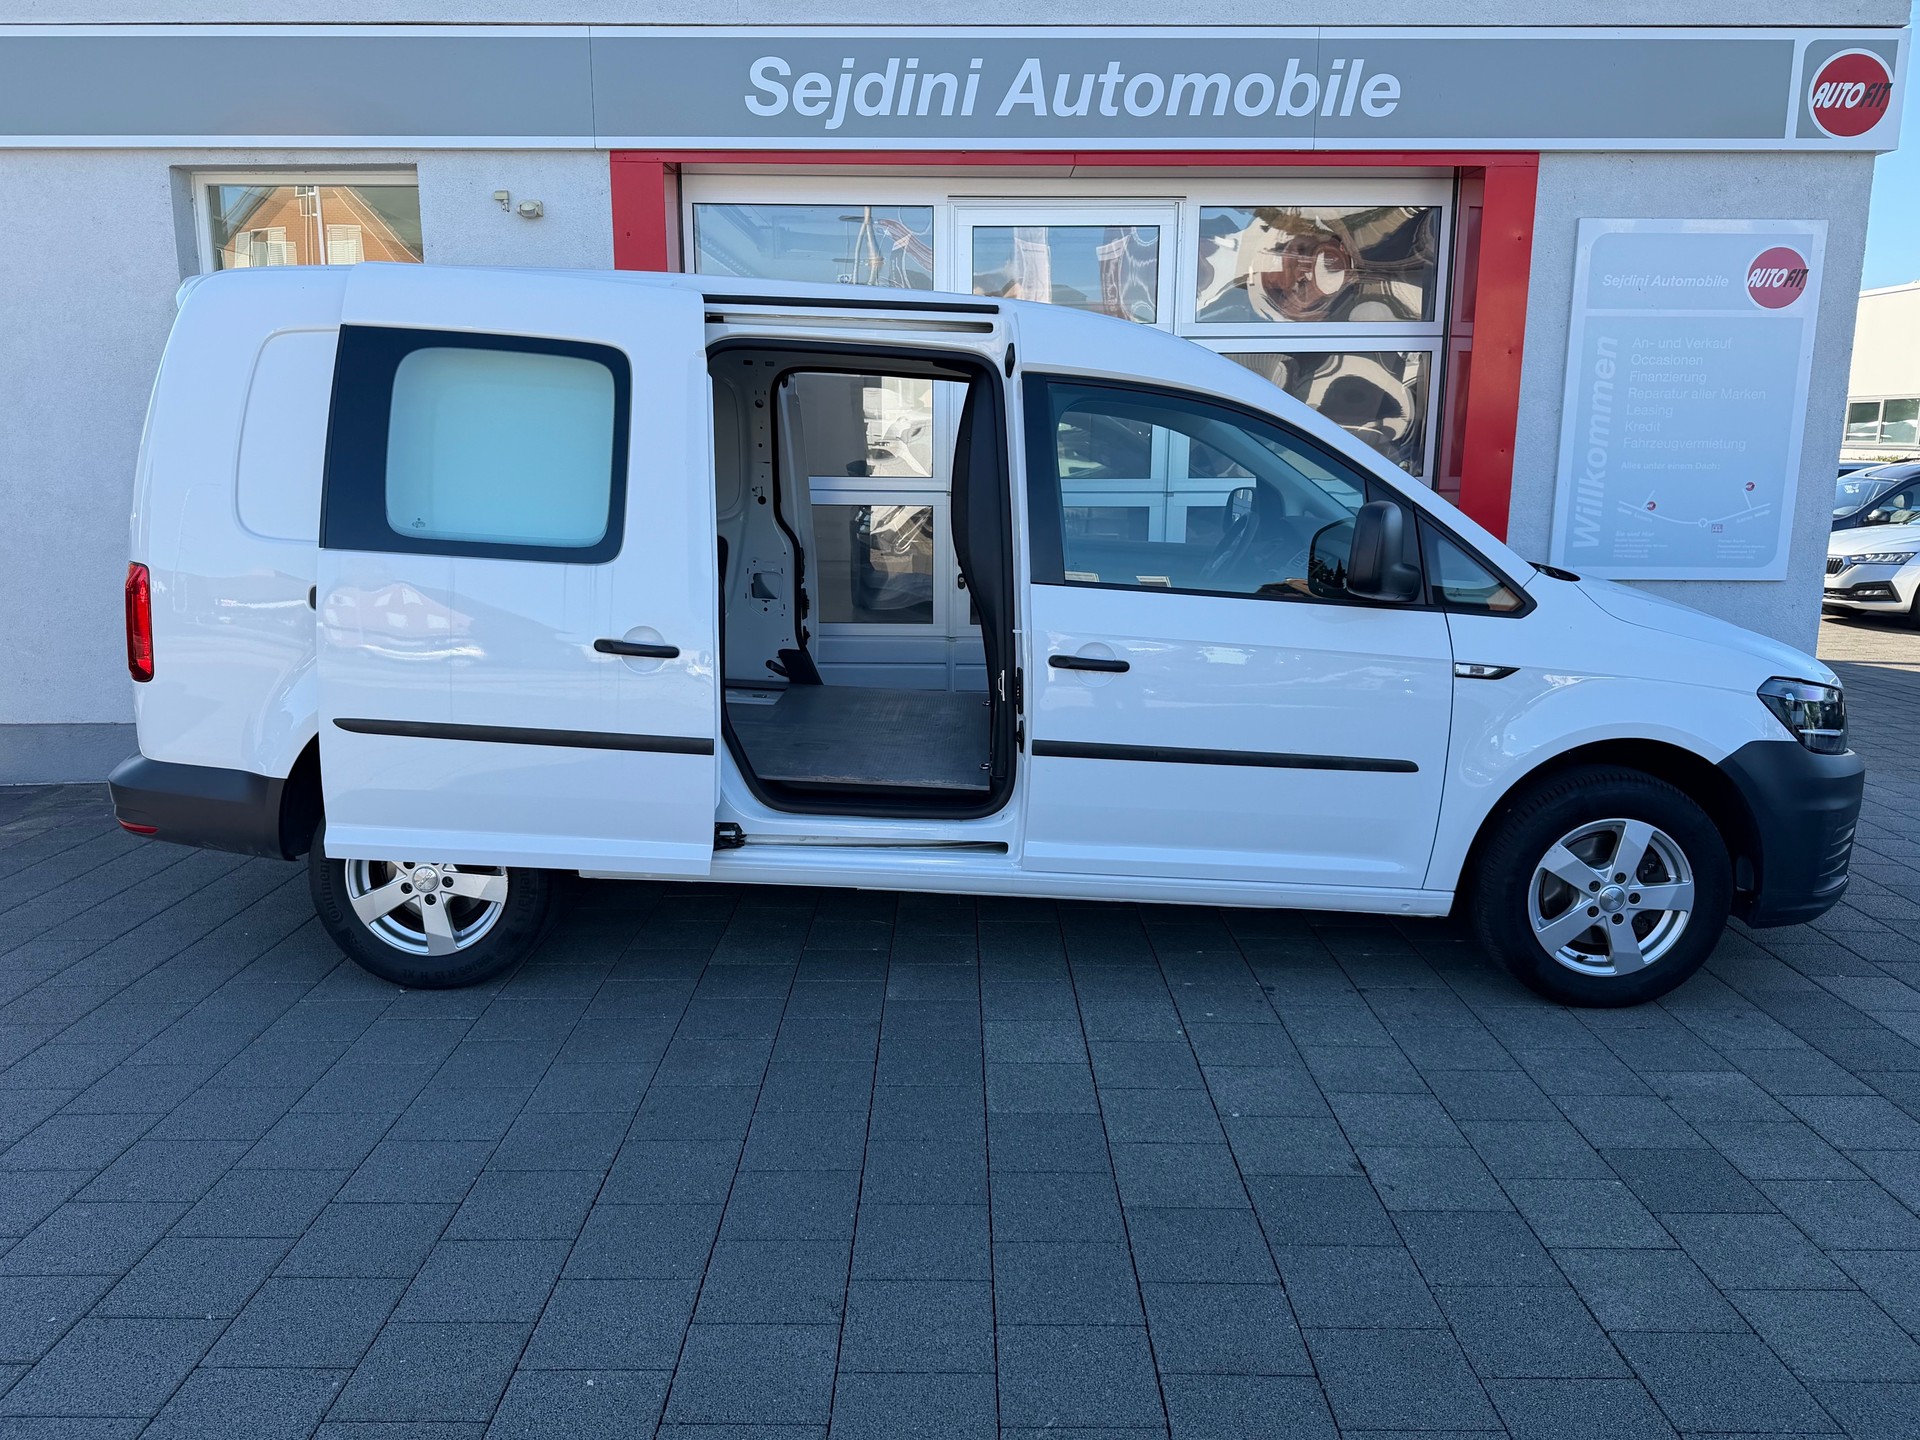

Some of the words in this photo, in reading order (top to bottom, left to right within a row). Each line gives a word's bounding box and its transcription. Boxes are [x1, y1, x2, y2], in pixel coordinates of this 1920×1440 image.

[744, 56, 983, 130] Sejdini
[996, 57, 1401, 118] Automobile
[1813, 82, 1893, 109] AUTOFIT
[1602, 274, 1650, 289] Sejdini
[1650, 274, 1729, 288] Automobile
[1746, 267, 1809, 288] AUTOFIT
[1631, 336, 1655, 349] An-
[1658, 337, 1681, 349] und
[1685, 337, 1733, 349] Verkauf
[1631, 353, 1703, 366] Occasionen
[1629, 370, 1707, 385] Finanzierung
[1628, 387, 1688, 401] Reparatur
[1691, 388, 1717, 400] aller
[1720, 387, 1766, 400] Marken
[1626, 404, 1673, 418] Leasing
[1624, 420, 1661, 432] Kredit
[1572, 335, 1619, 548] Willkommen
[1623, 437, 1746, 451] Fahrzeugvermietung
